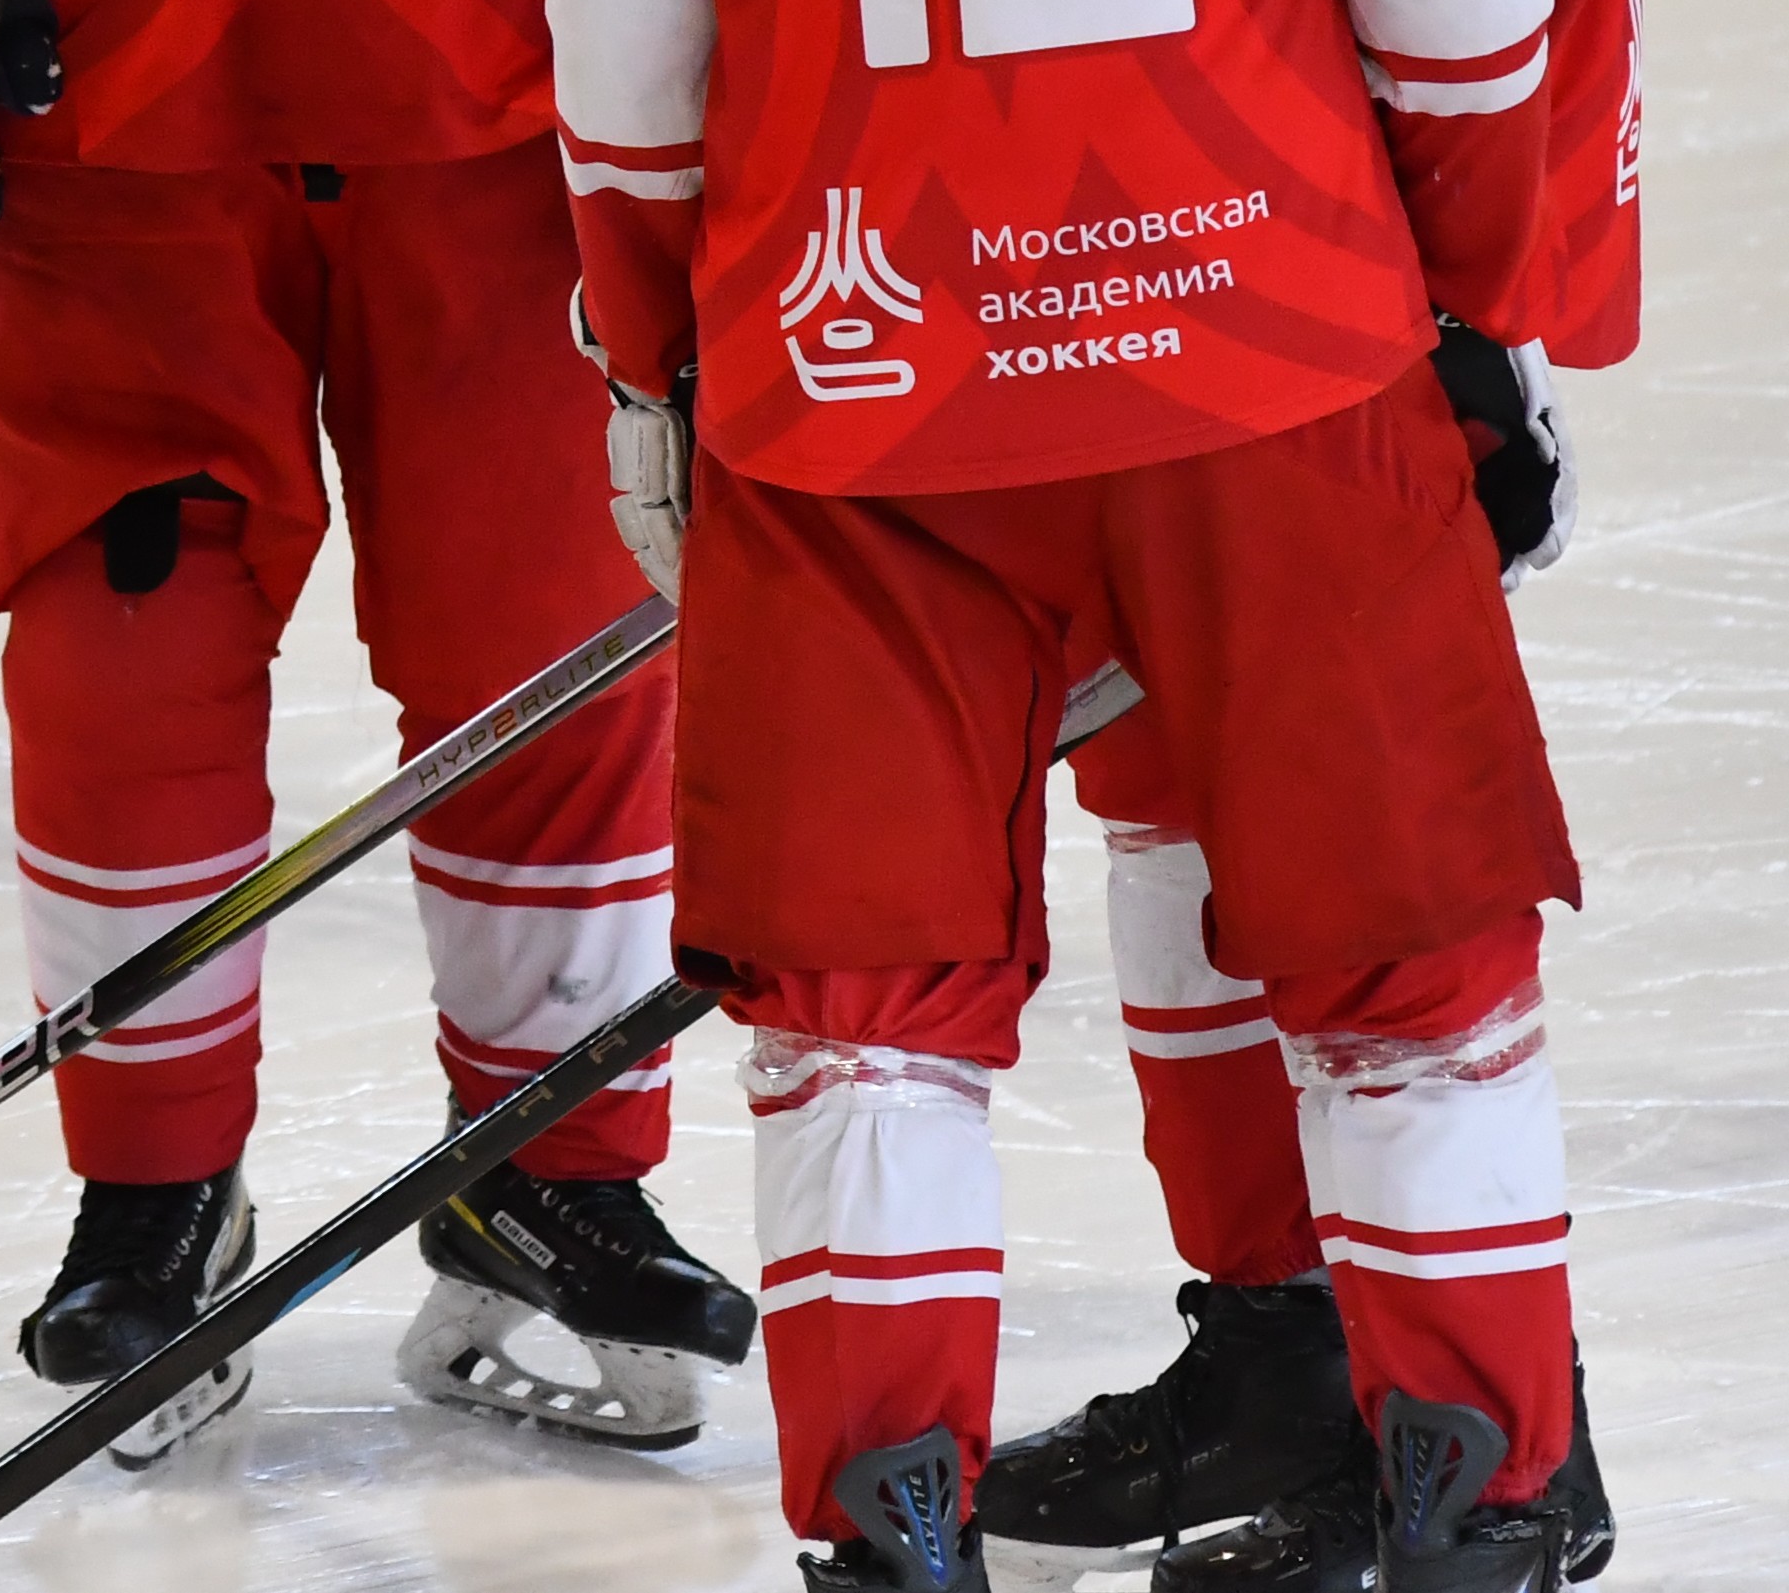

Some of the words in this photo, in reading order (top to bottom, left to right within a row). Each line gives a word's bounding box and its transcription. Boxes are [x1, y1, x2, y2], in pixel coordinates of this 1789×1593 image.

[972, 190, 1270, 266] Московская
[978, 259, 1234, 323] академия
[985, 327, 1182, 380] хоккея
[418, 633, 626, 788] HYP2RLITE
